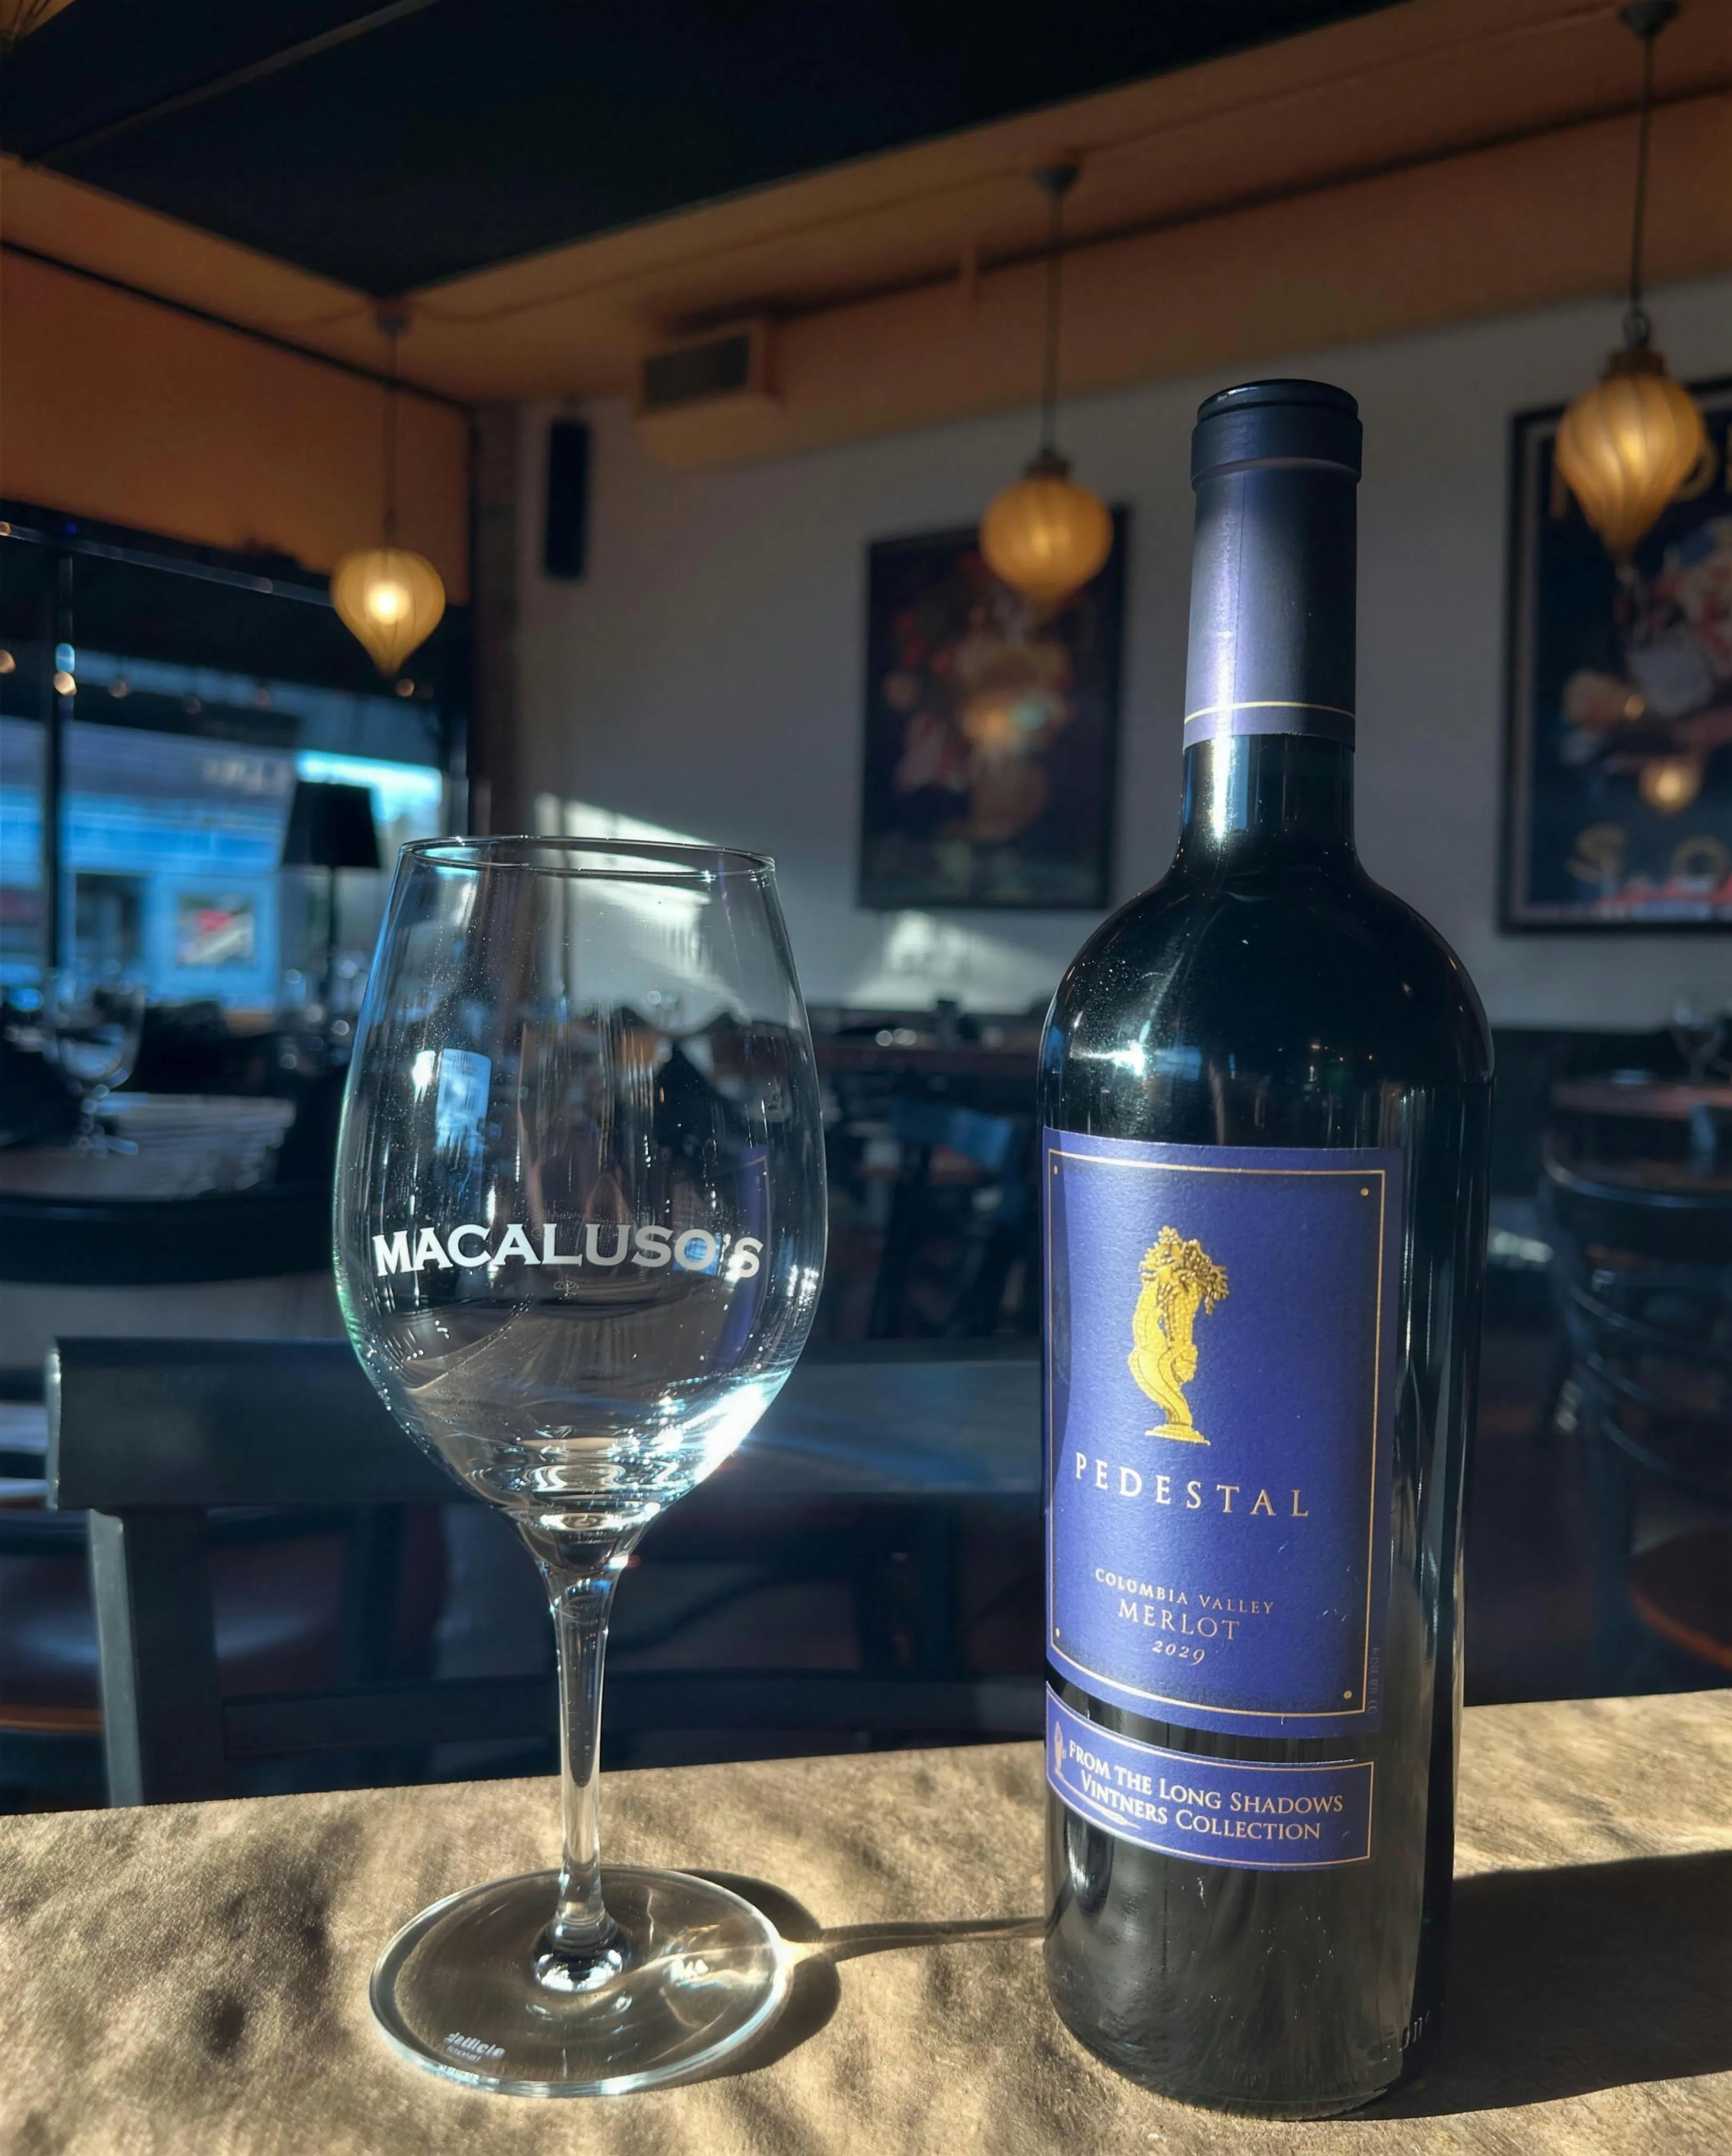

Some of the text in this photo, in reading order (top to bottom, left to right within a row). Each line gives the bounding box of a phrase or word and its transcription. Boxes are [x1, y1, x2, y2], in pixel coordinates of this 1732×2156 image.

[372, 1223, 764, 1278] MACALUSO'S
[1075, 1452, 1309, 1517] PEDESTAL
[1095, 1568, 1275, 1614] COLOMBIA VALLEY
[1118, 1598, 1239, 1641] MERLOT
[1152, 1640, 1206, 1666] 2029
[1069, 1739, 1112, 1780] FROM
[1114, 1764, 1153, 1795] THE
